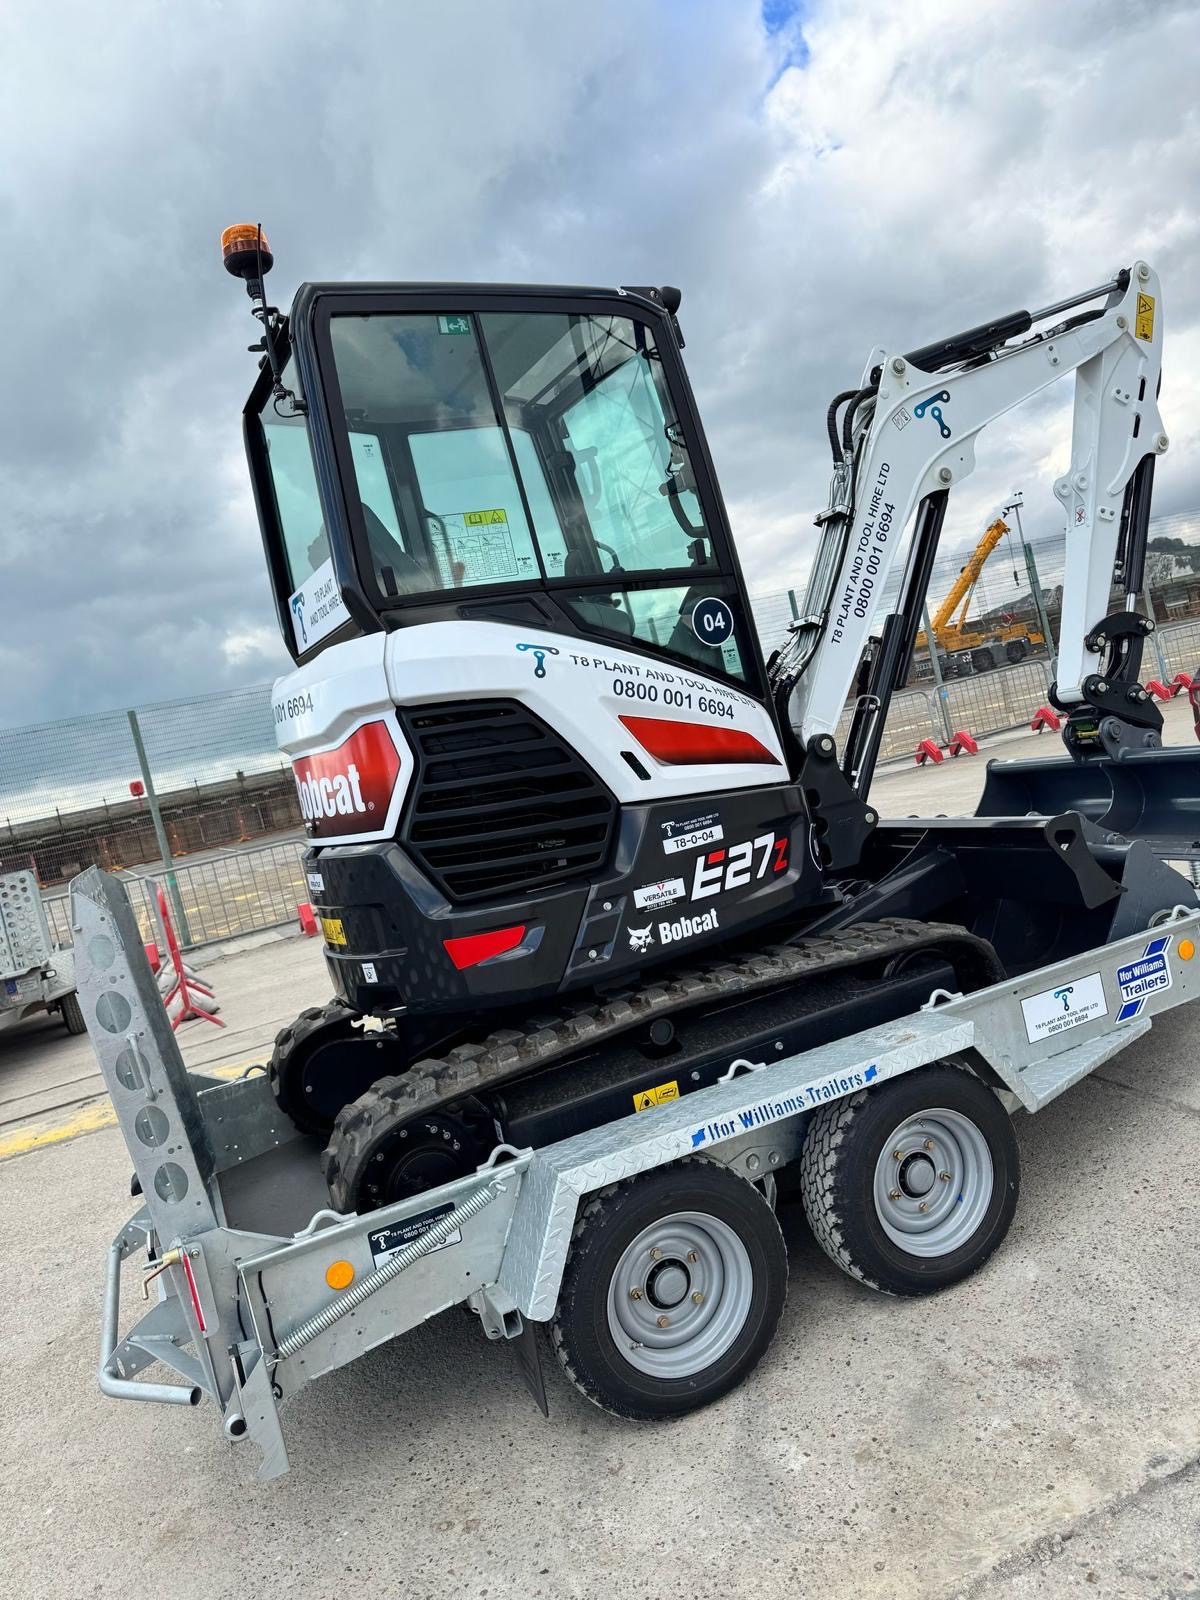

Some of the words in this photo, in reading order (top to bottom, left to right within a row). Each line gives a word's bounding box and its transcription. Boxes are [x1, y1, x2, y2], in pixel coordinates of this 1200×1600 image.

[877, 462, 890, 486] LTD
[868, 486, 884, 518] HIRE
[857, 521, 875, 553] TOOL
[849, 556, 864, 585] AND
[853, 578, 874, 618] 0800
[866, 545, 883, 576] 001
[875, 502, 896, 542] 6694
[836, 584, 855, 628] PLANT
[703, 611, 726, 632] 04
[831, 629, 843, 644] T8
[569, 654, 590, 667] T8
[592, 658, 641, 677] PLANT
[645, 668, 675, 683] AND
[676, 675, 712, 693] TOOL
[711, 685, 739, 702] HIRE
[287, 692, 314, 719] 6694
[613, 678, 658, 702] 0800
[663, 688, 692, 709] 001
[698, 696, 735, 720] 6694
[673, 830, 714, 849] T8-0-04
[643, 888, 677, 902] VERSATILE
[658, 908, 719, 945] Bobcat
[1119, 970, 1133, 982] Ifor
[1132, 959, 1164, 978] Williams
[1122, 974, 1167, 998] Trailers
[708, 1120, 736, 1140] Ifor
[738, 1094, 805, 1129] Williams
[805, 1073, 863, 1103] Trailers
